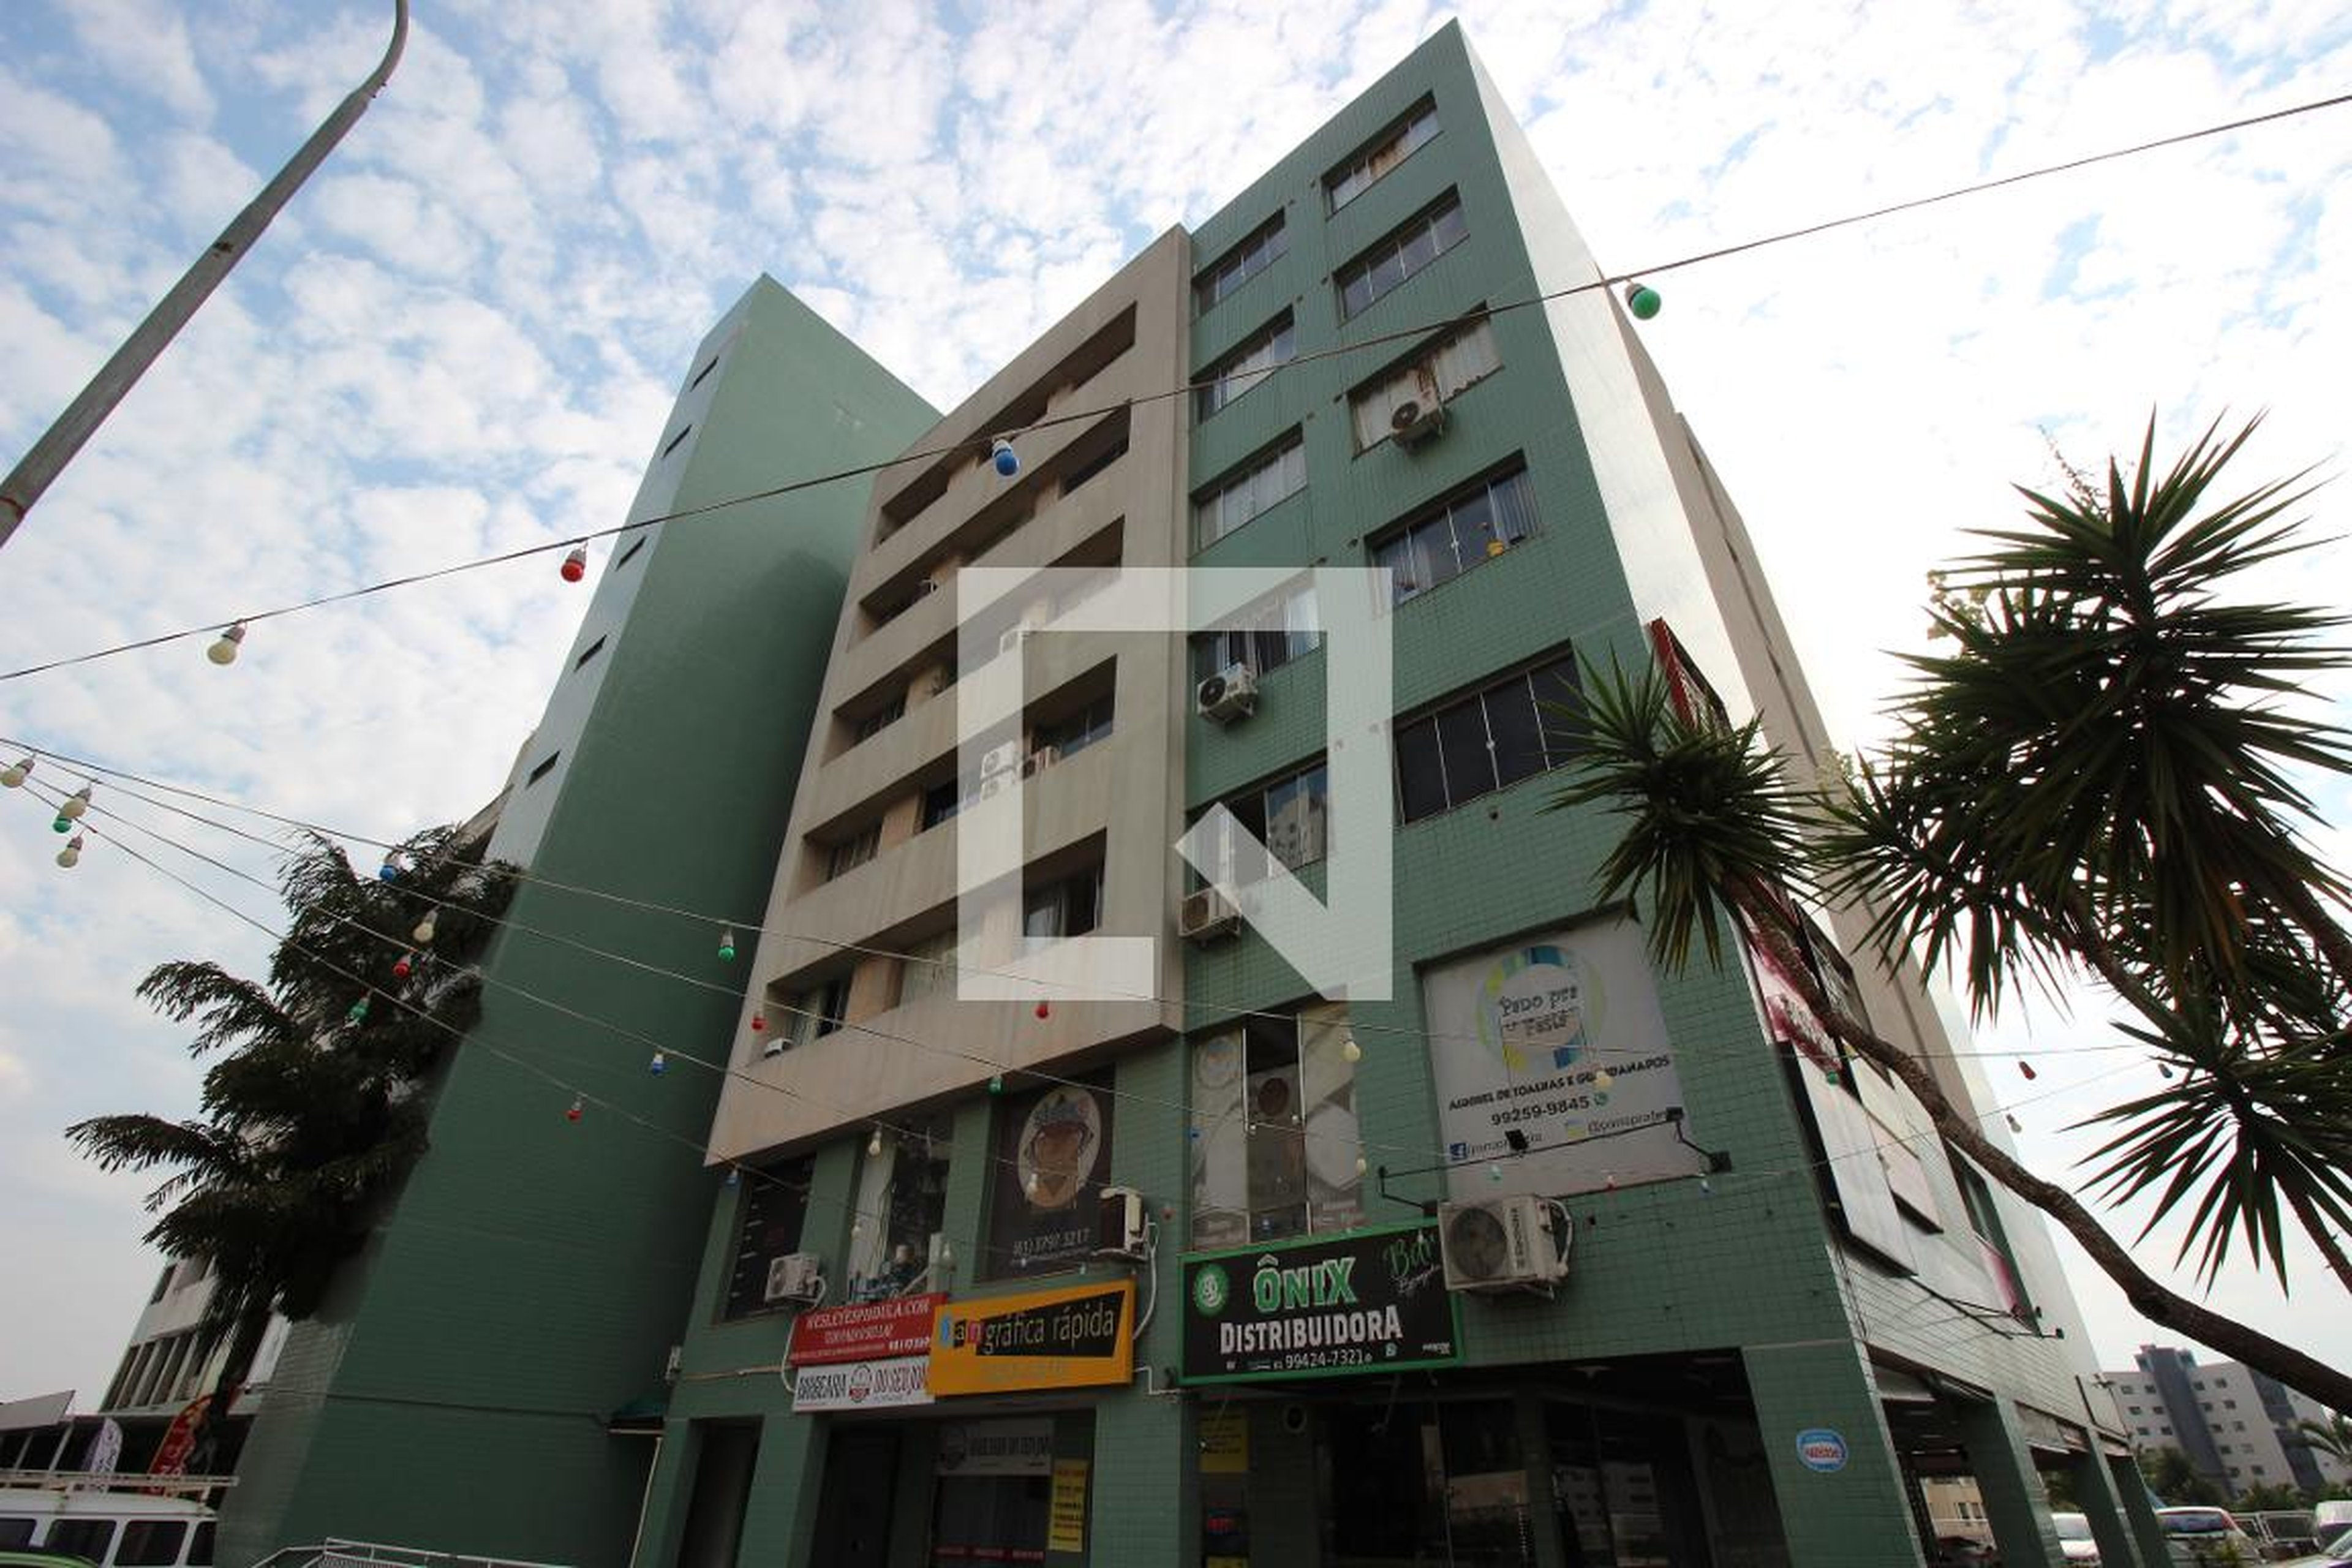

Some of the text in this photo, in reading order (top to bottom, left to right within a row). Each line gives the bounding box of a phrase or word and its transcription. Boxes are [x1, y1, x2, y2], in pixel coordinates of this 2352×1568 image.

[1490, 1095, 1590, 1126] 99259-9845
[1253, 1253, 1360, 1313] ÔNIX
[985, 1314, 1045, 1355] gráfica
[1053, 1302, 1115, 1349] rápida
[1219, 1305, 1404, 1355] DISTRIBUIDORA
